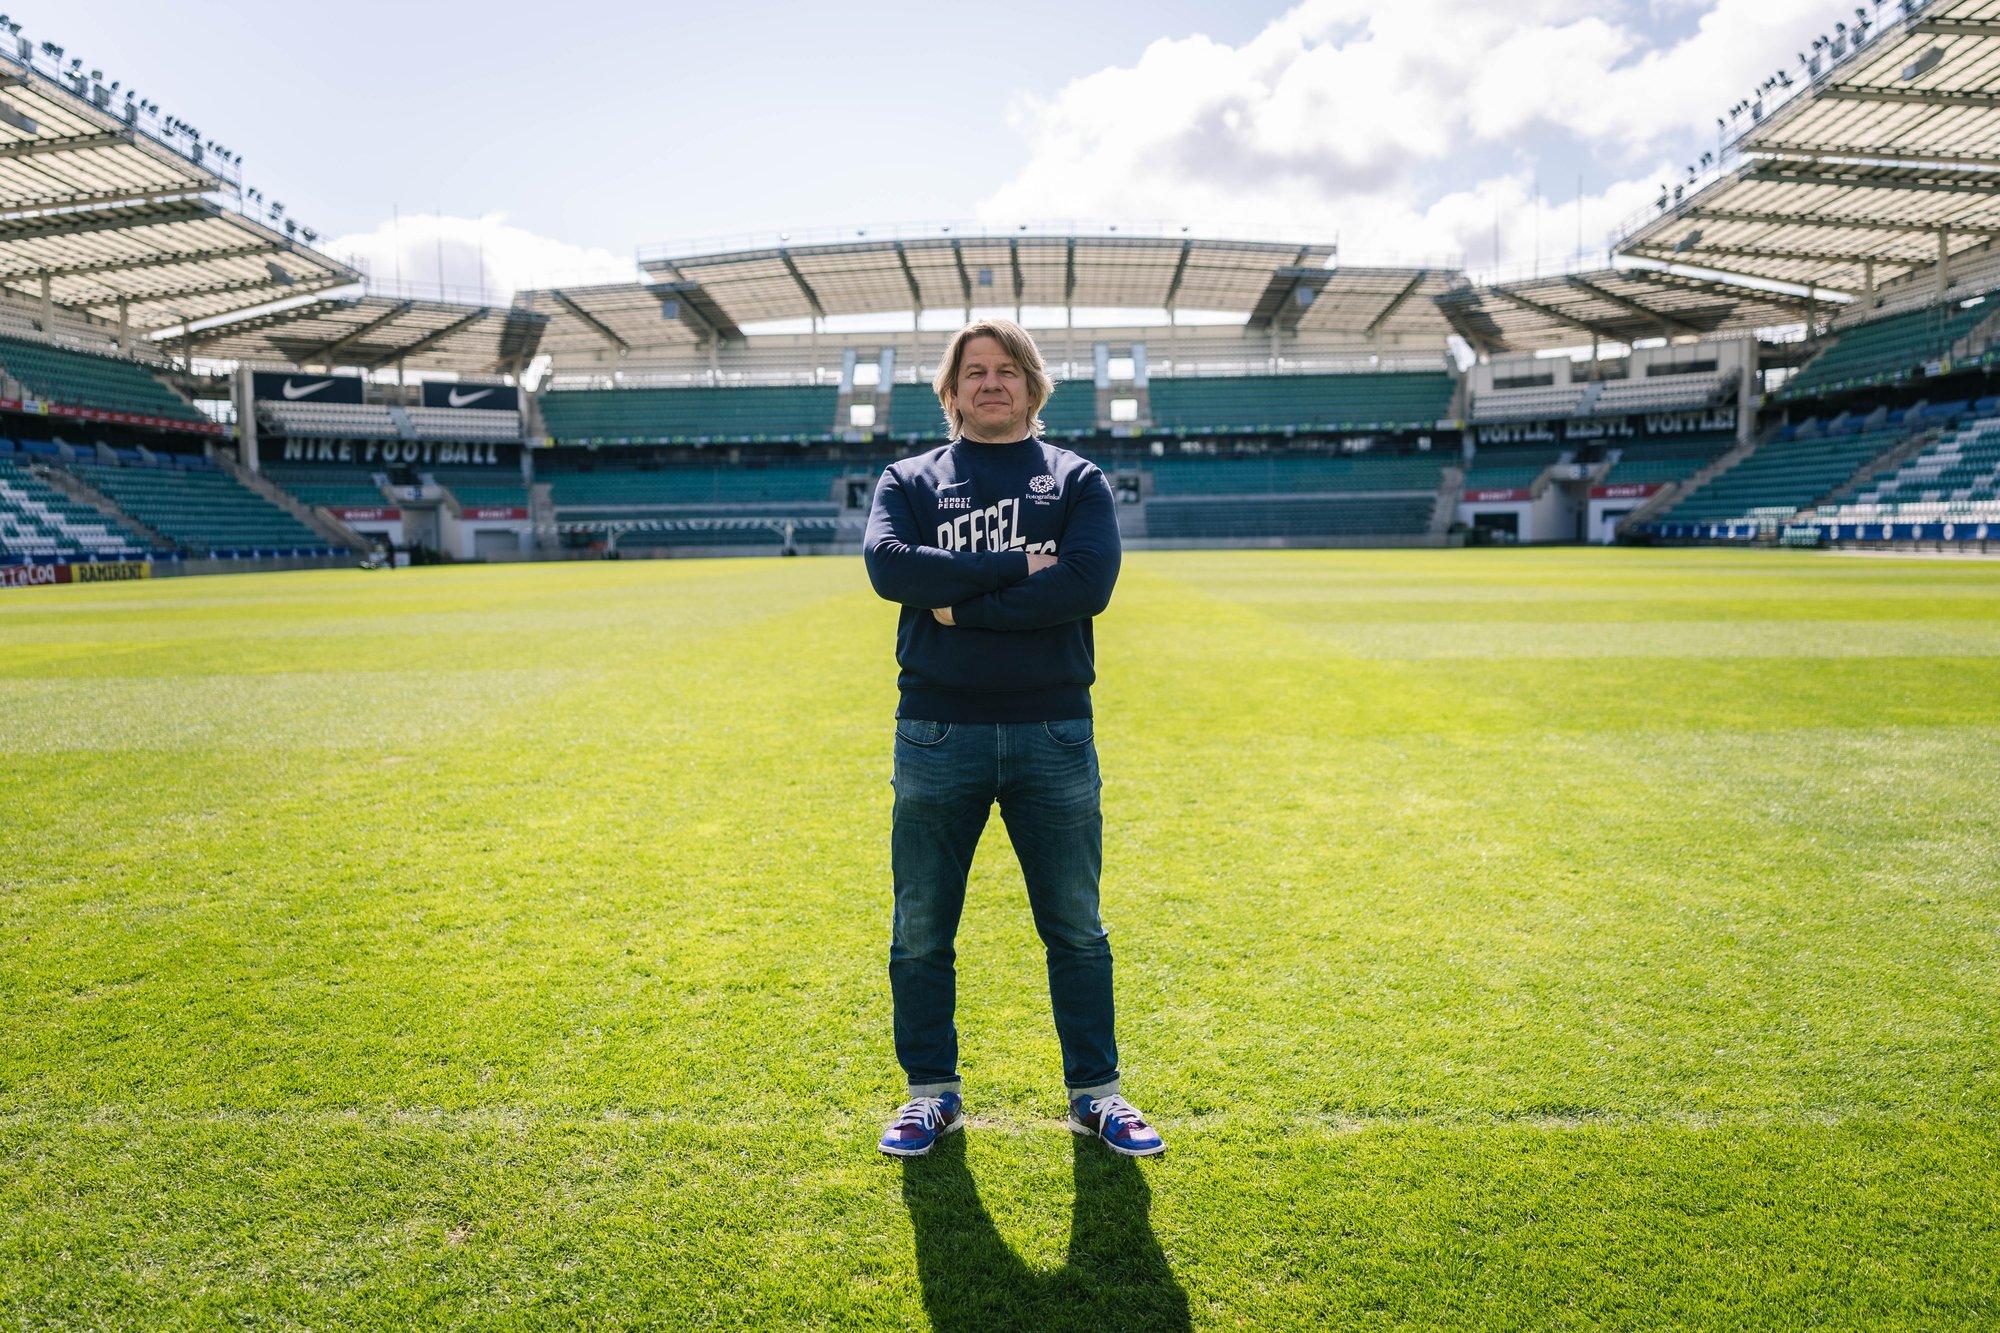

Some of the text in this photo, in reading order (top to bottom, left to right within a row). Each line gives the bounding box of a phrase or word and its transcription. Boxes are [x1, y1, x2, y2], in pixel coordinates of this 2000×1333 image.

[284, 438, 498, 464] NIKE FOOTBALL
[1025, 493, 1061, 501] Fotografiska
[79, 562, 143, 582] RAMIRENT
